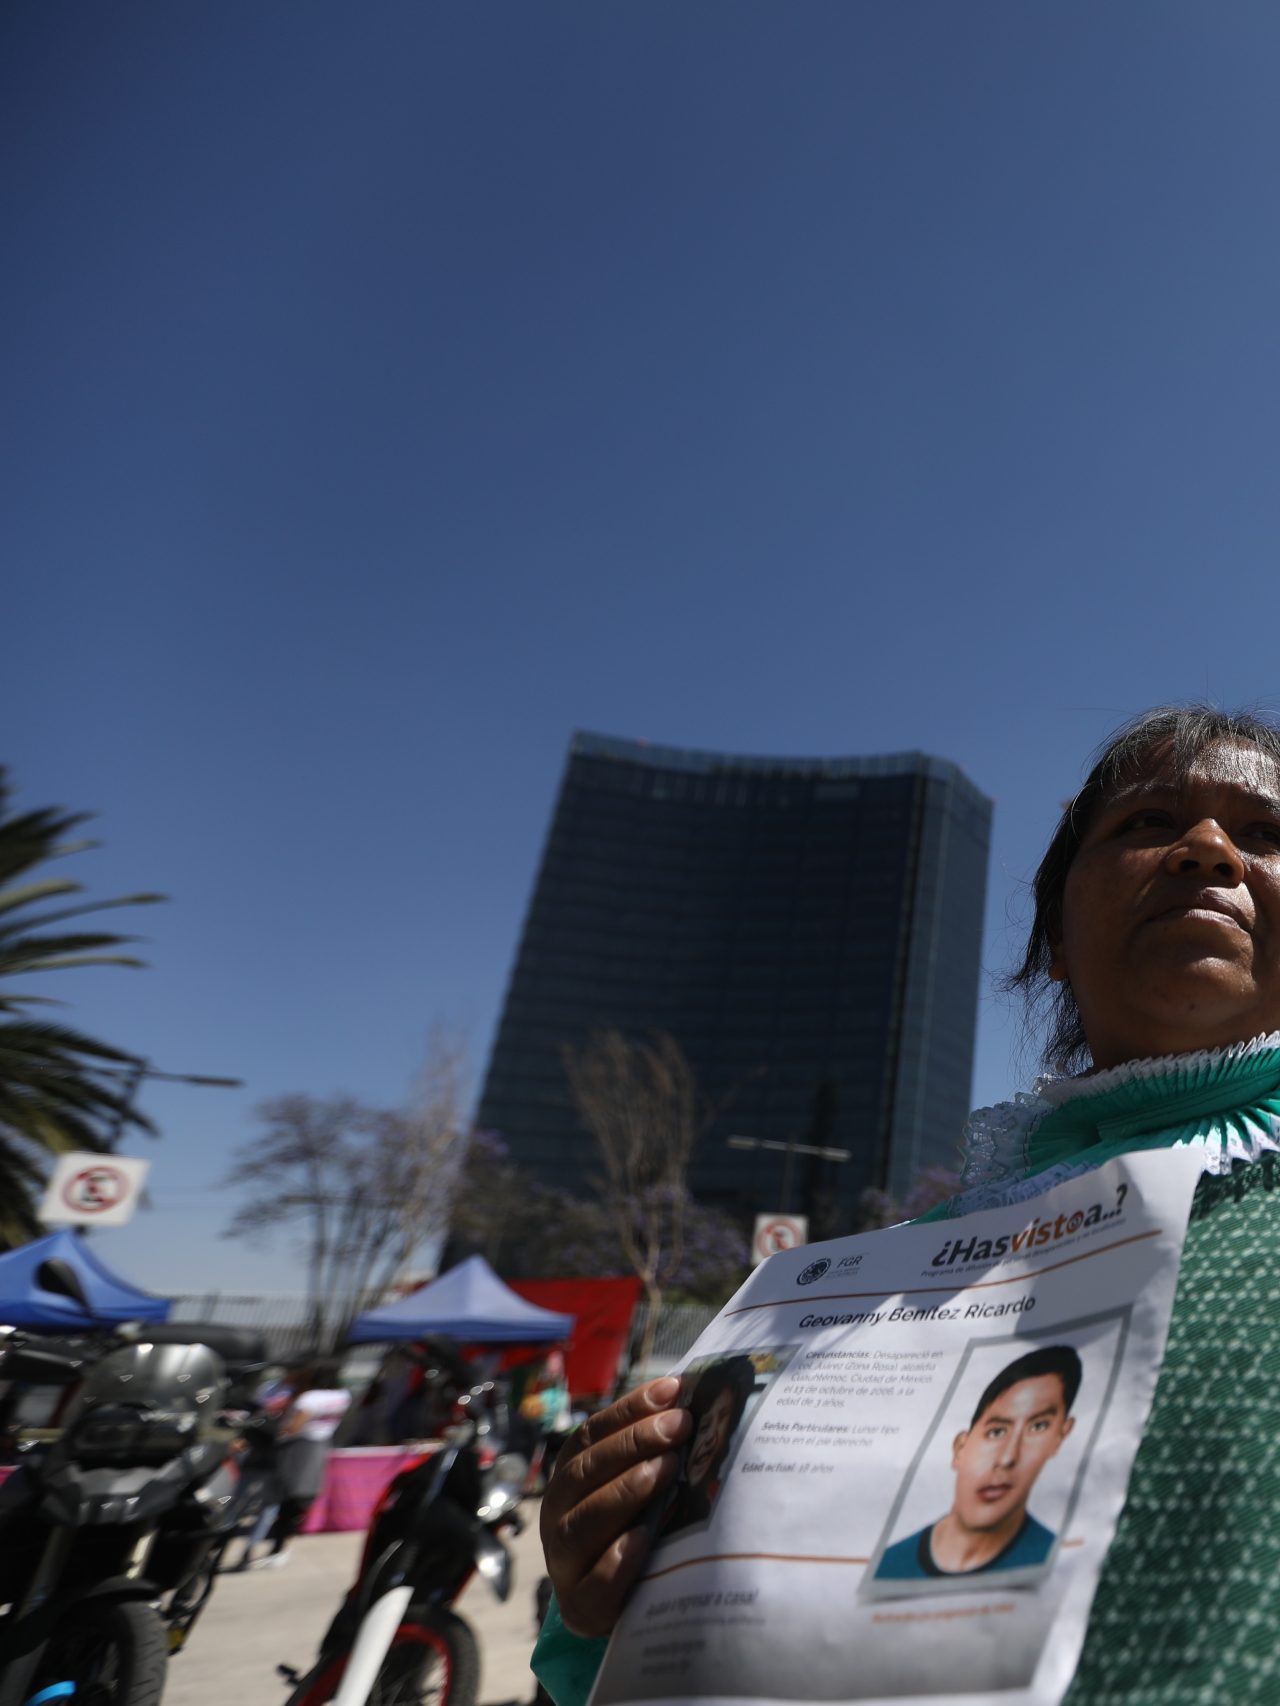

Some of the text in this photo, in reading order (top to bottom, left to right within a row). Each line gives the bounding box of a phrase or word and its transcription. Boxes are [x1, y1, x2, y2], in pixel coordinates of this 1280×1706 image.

[799, 1313, 886, 1329] Geovanny
[963, 1296, 1036, 1319] Ricardo
[742, 1463, 765, 1473] Edad
